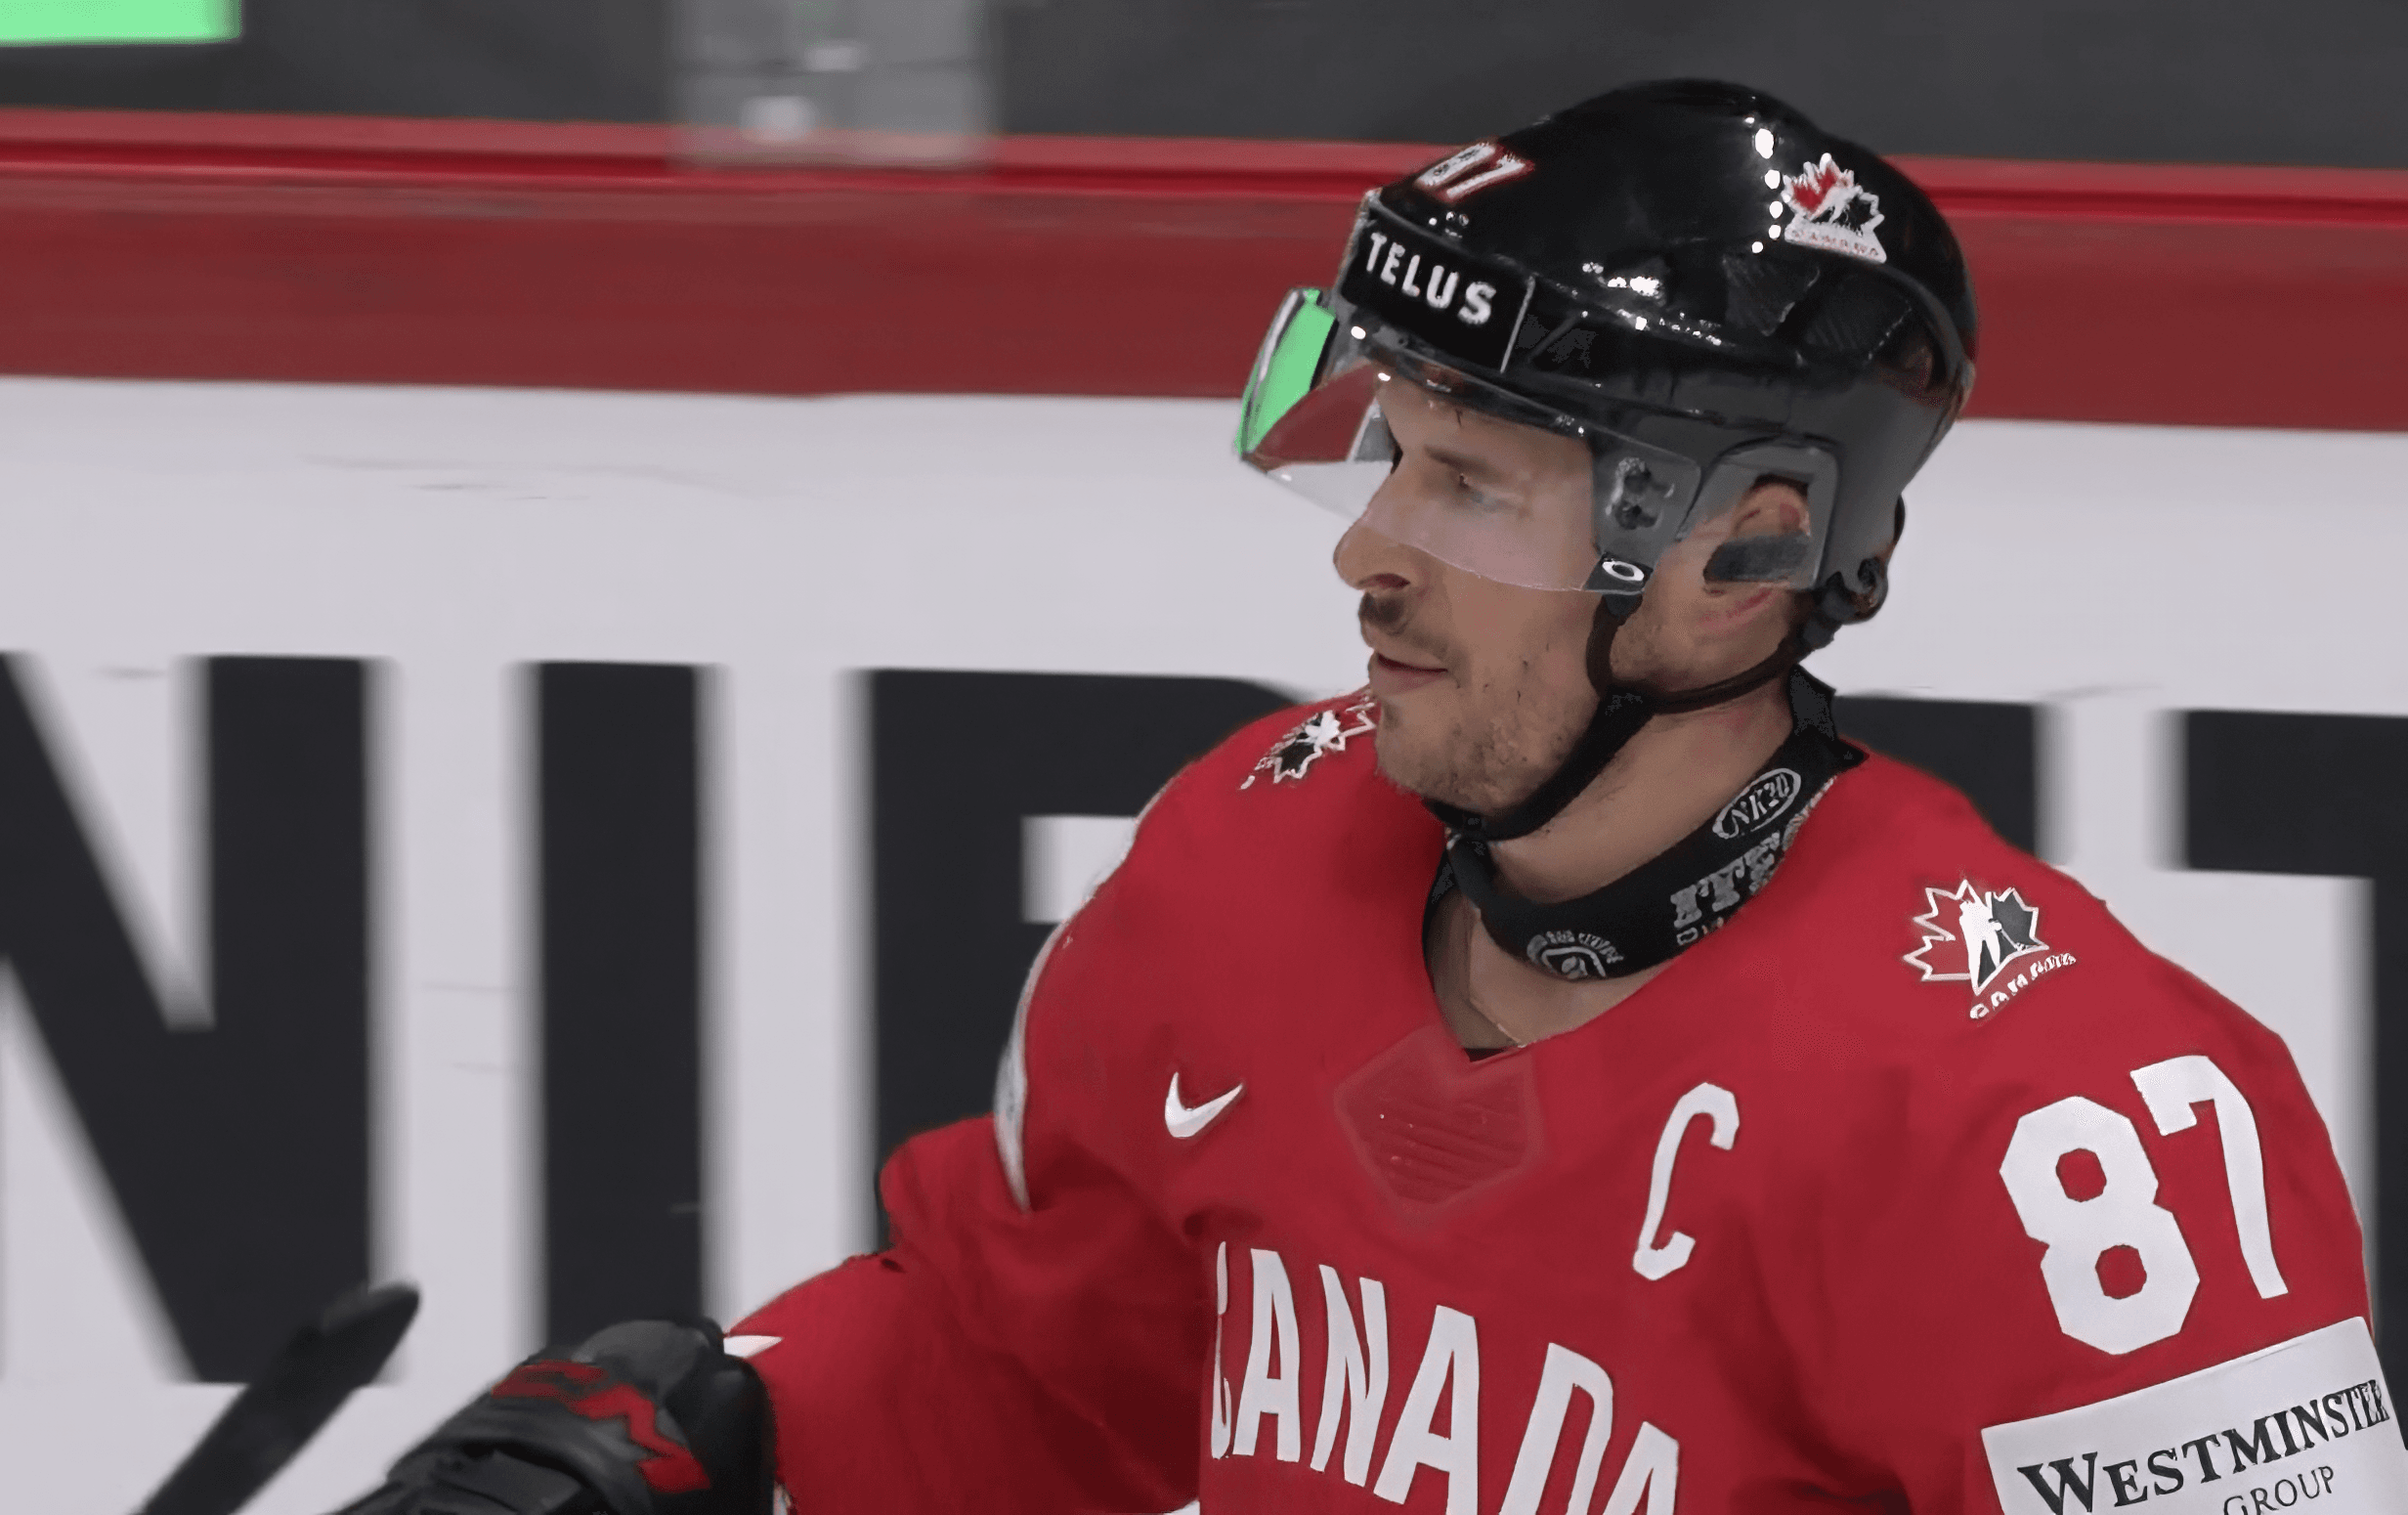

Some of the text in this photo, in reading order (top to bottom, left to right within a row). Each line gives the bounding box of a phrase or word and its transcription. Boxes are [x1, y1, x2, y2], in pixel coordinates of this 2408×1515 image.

[1366, 232, 1497, 325] TELUS
[1633, 1082, 1740, 1280] C
[2000, 1055, 2289, 1356] 87
[2017, 1379, 2390, 1515] WESTMINSTER
[2223, 1465, 2335, 1515] GROUP
